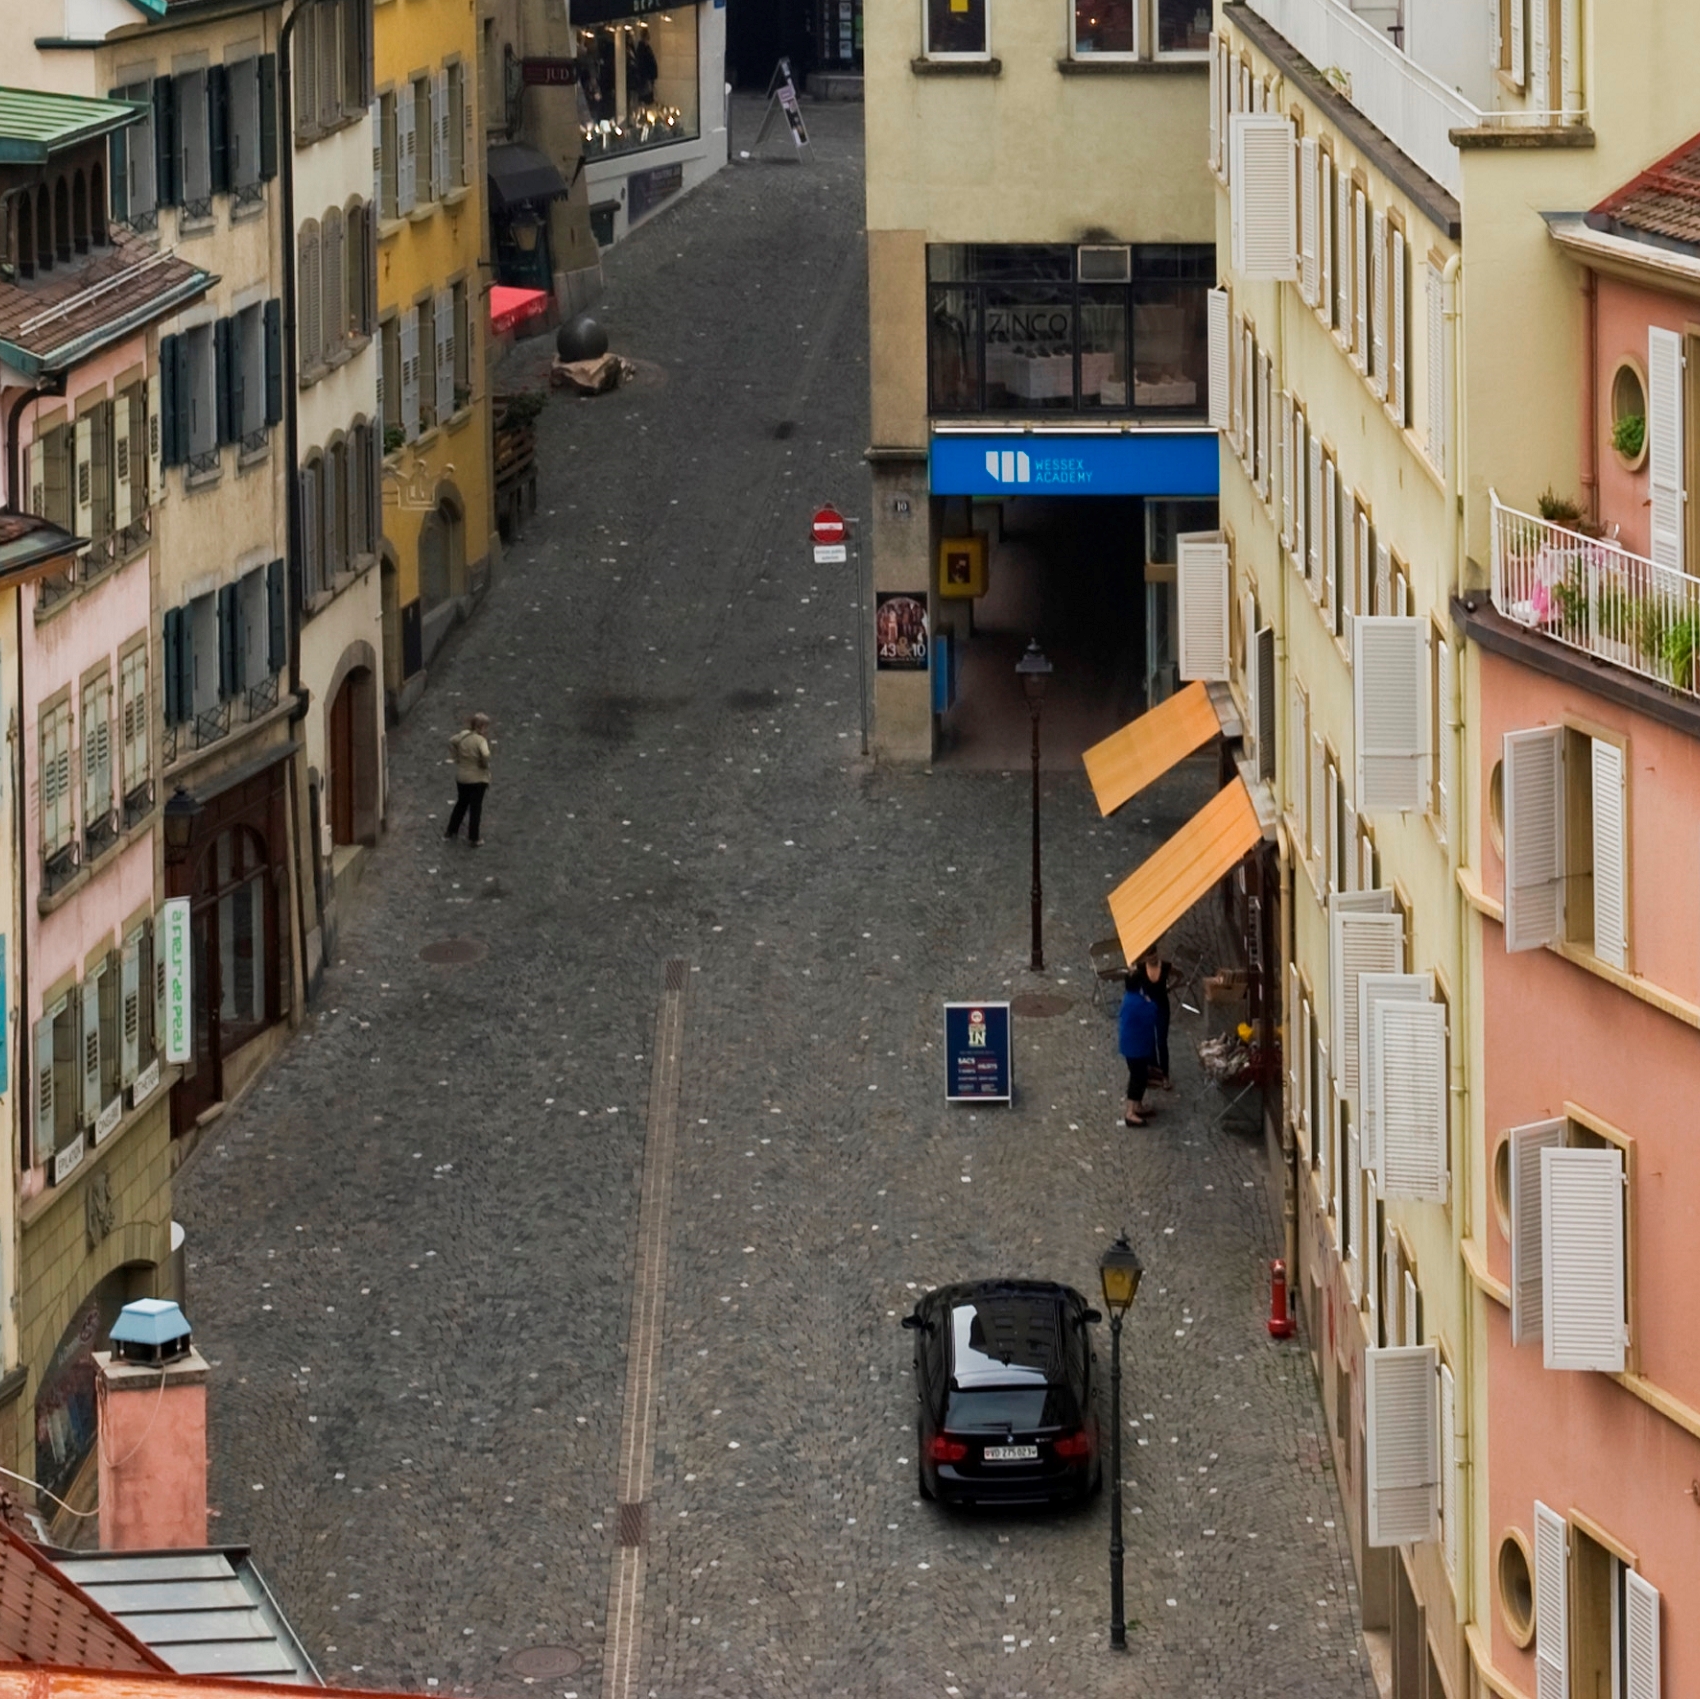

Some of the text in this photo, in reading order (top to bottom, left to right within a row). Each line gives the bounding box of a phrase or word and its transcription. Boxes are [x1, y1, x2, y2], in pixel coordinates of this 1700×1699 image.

[545, 68, 570, 83] JUD
[988, 313, 1068, 335] ZINCO
[1035, 458, 1084, 470] WESSEX
[1035, 472, 1093, 484] ACADEMY
[897, 501, 907, 512] 10
[880, 643, 897, 657] 43
[912, 643, 927, 657] 10
[171, 978, 183, 1005] de
[171, 1006, 183, 1054] peau
